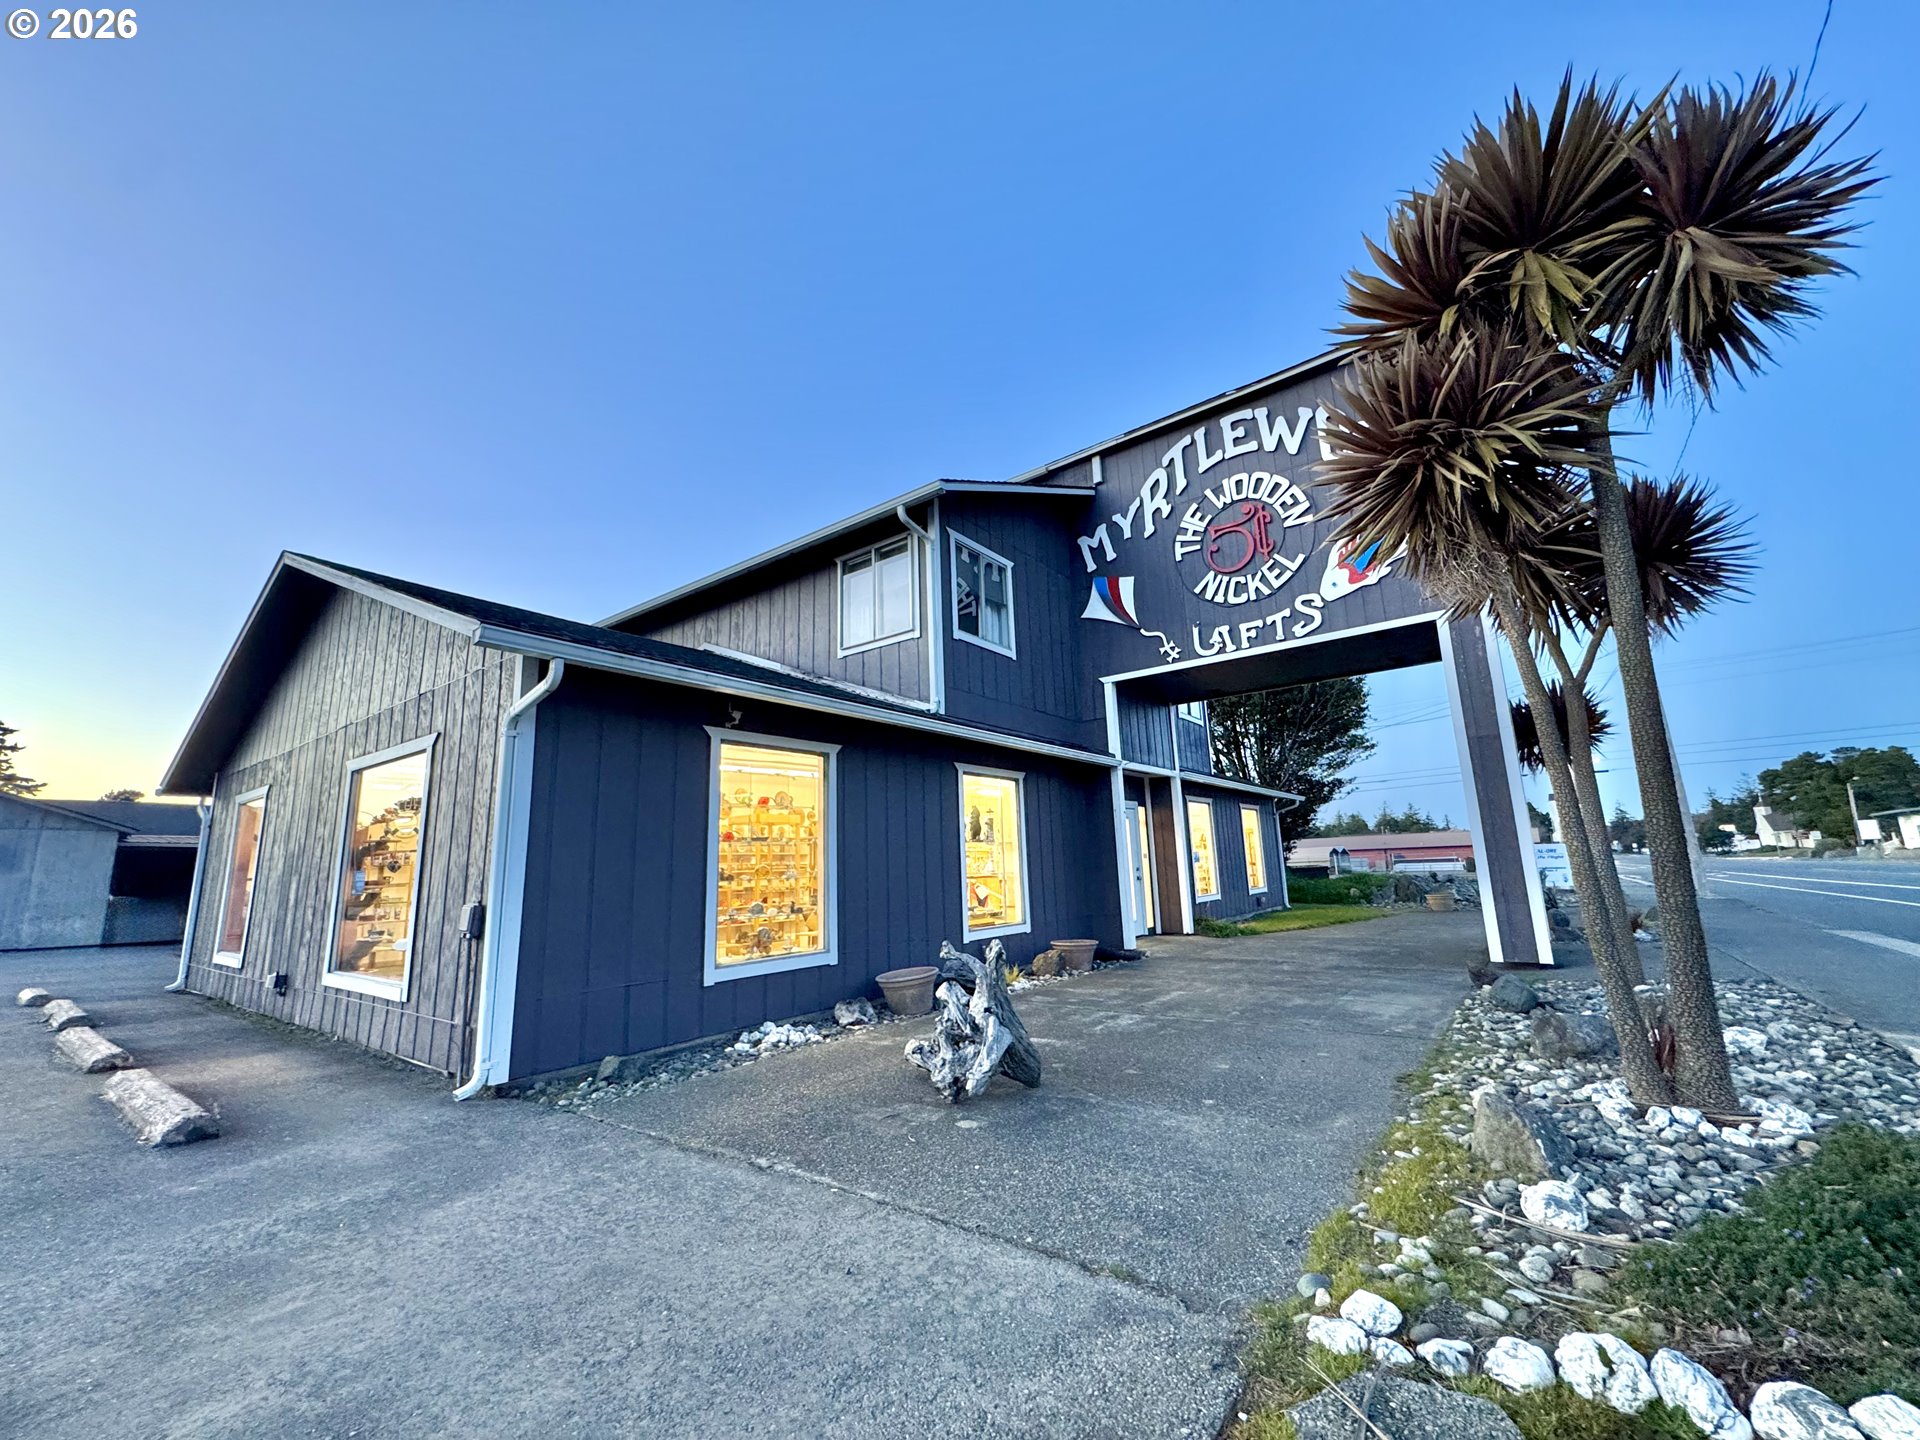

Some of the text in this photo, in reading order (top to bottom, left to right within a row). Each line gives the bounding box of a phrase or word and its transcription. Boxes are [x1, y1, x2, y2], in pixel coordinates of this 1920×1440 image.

[1174, 471, 1314, 562] THE WOODEN
[1193, 553, 1306, 605] NICKEL
